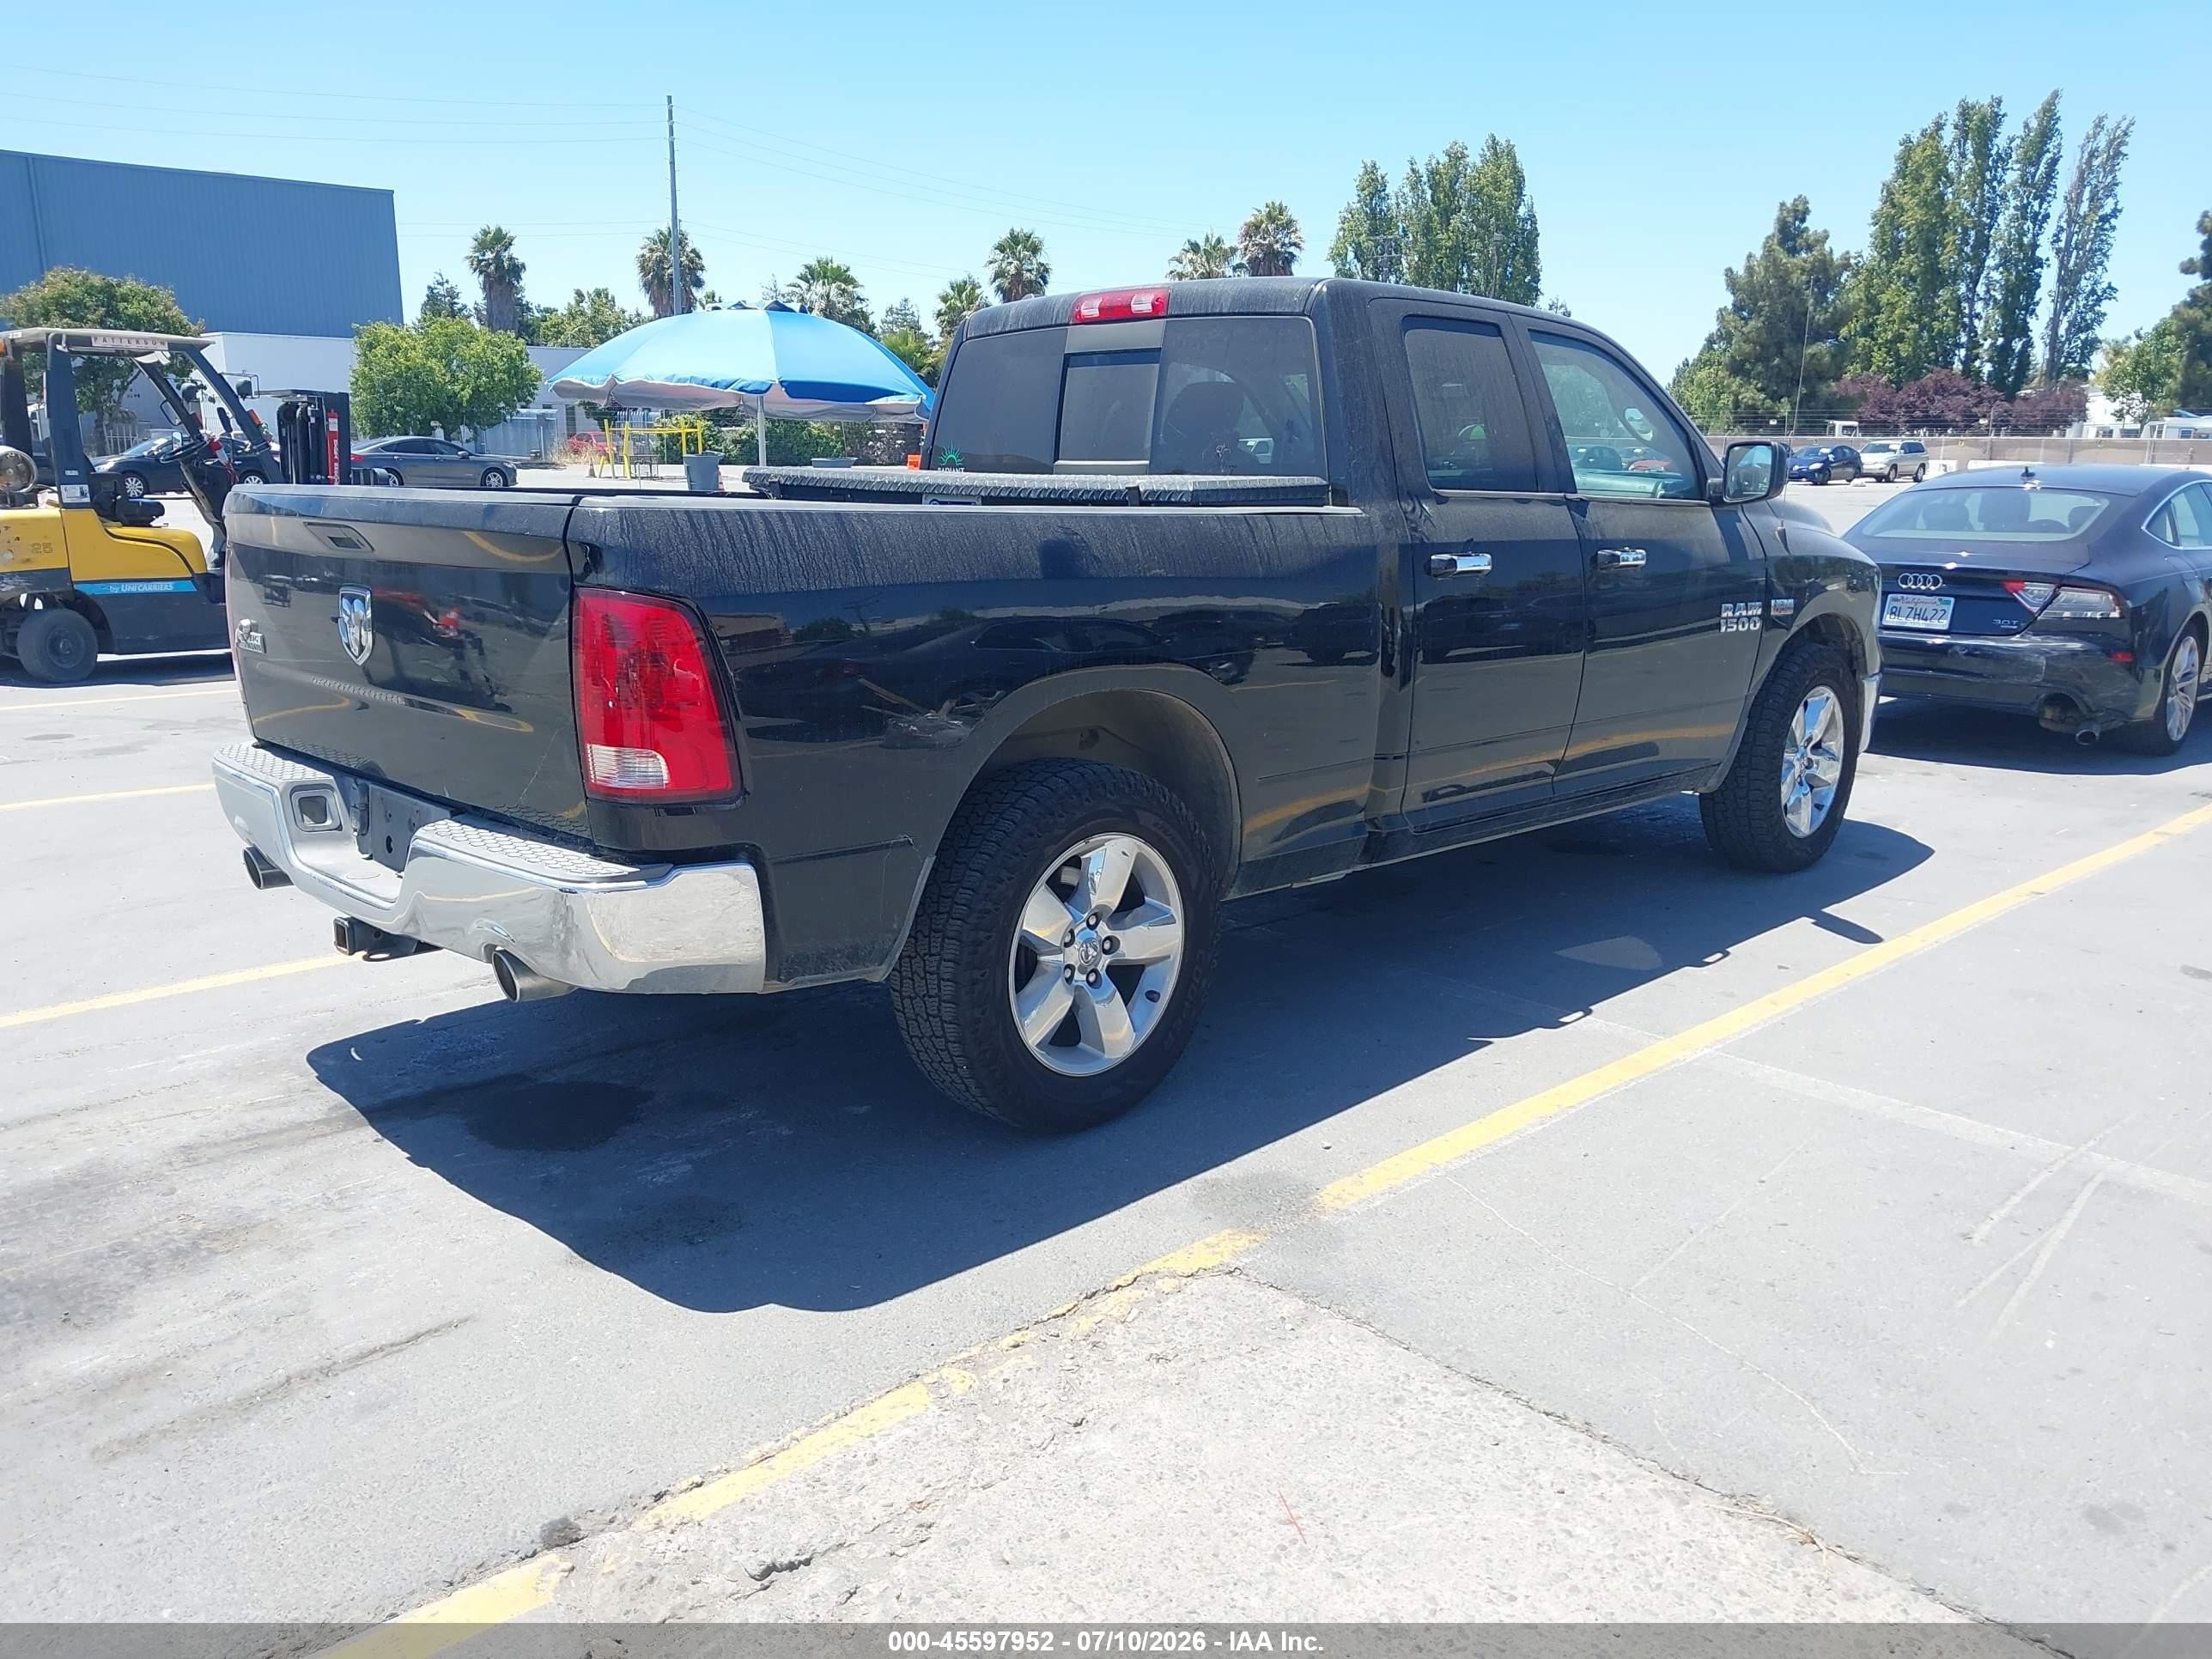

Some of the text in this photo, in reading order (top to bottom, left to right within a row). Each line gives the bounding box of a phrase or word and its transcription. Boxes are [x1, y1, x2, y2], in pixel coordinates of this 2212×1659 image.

[94, 336, 166, 346] PATTERSON
[110, 581, 173, 593] by UNICARRIERS
[1900, 595, 1937, 606] California
[1721, 602, 1762, 617] RAM
[1889, 605, 1948, 623] 8LZH422
[1720, 617, 1761, 633] 1500
